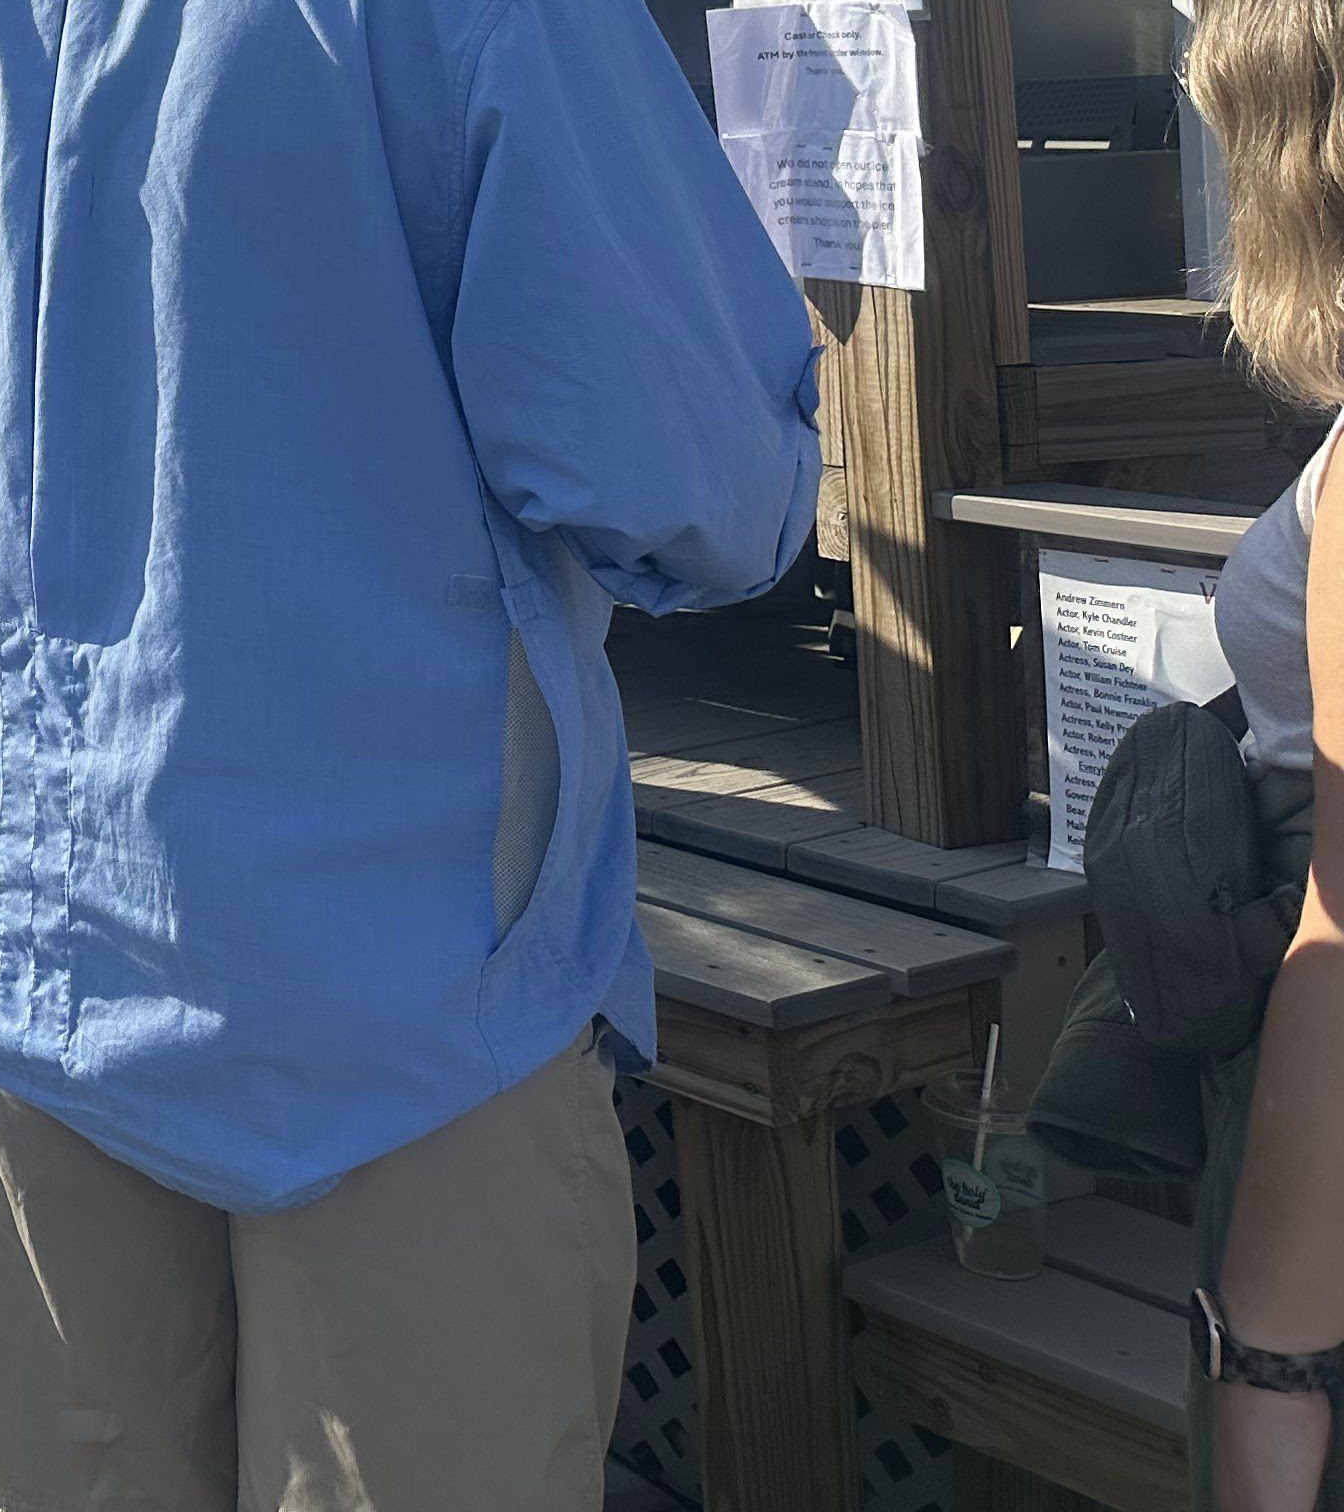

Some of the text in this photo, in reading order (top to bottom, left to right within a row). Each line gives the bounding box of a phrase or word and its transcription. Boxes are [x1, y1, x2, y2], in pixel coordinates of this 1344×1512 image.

[757, 51, 779, 61] ATM
[782, 51, 794, 60] by
[812, 160, 828, 169] not
[872, 161, 888, 171] ice
[769, 179, 803, 190] cream
[844, 180, 874, 192] hopes
[876, 181, 896, 191] that
[774, 198, 794, 208] you
[860, 200, 877, 210] the
[879, 200, 894, 211] ice
[778, 216, 808, 225] cream
[813, 237, 842, 249] Thank
[1056, 592, 1125, 610] Andrew Zimmern
[1057, 607, 1137, 628] Actor, Kyle Chandler
[1057, 622, 1137, 643] Actor, Kevin Costner
[1058, 637, 1127, 657] Actor, Tom Cruise
[1059, 653, 1135, 676] Actress, Susan Dey
[1059, 668, 1081, 680] Actor,
[1084, 671, 1112, 685] William
[1060, 683, 1157, 710] Actress, Bonnie Franklin
[1061, 698, 1083, 711] Actor,
[1085, 702, 1102, 714] Paul
[1061, 714, 1094, 728] Actress,
[1096, 720, 1115, 733] Kelly
[1063, 729, 1115, 746] Actor, Robert
[1063, 743, 1096, 759] Actress,
